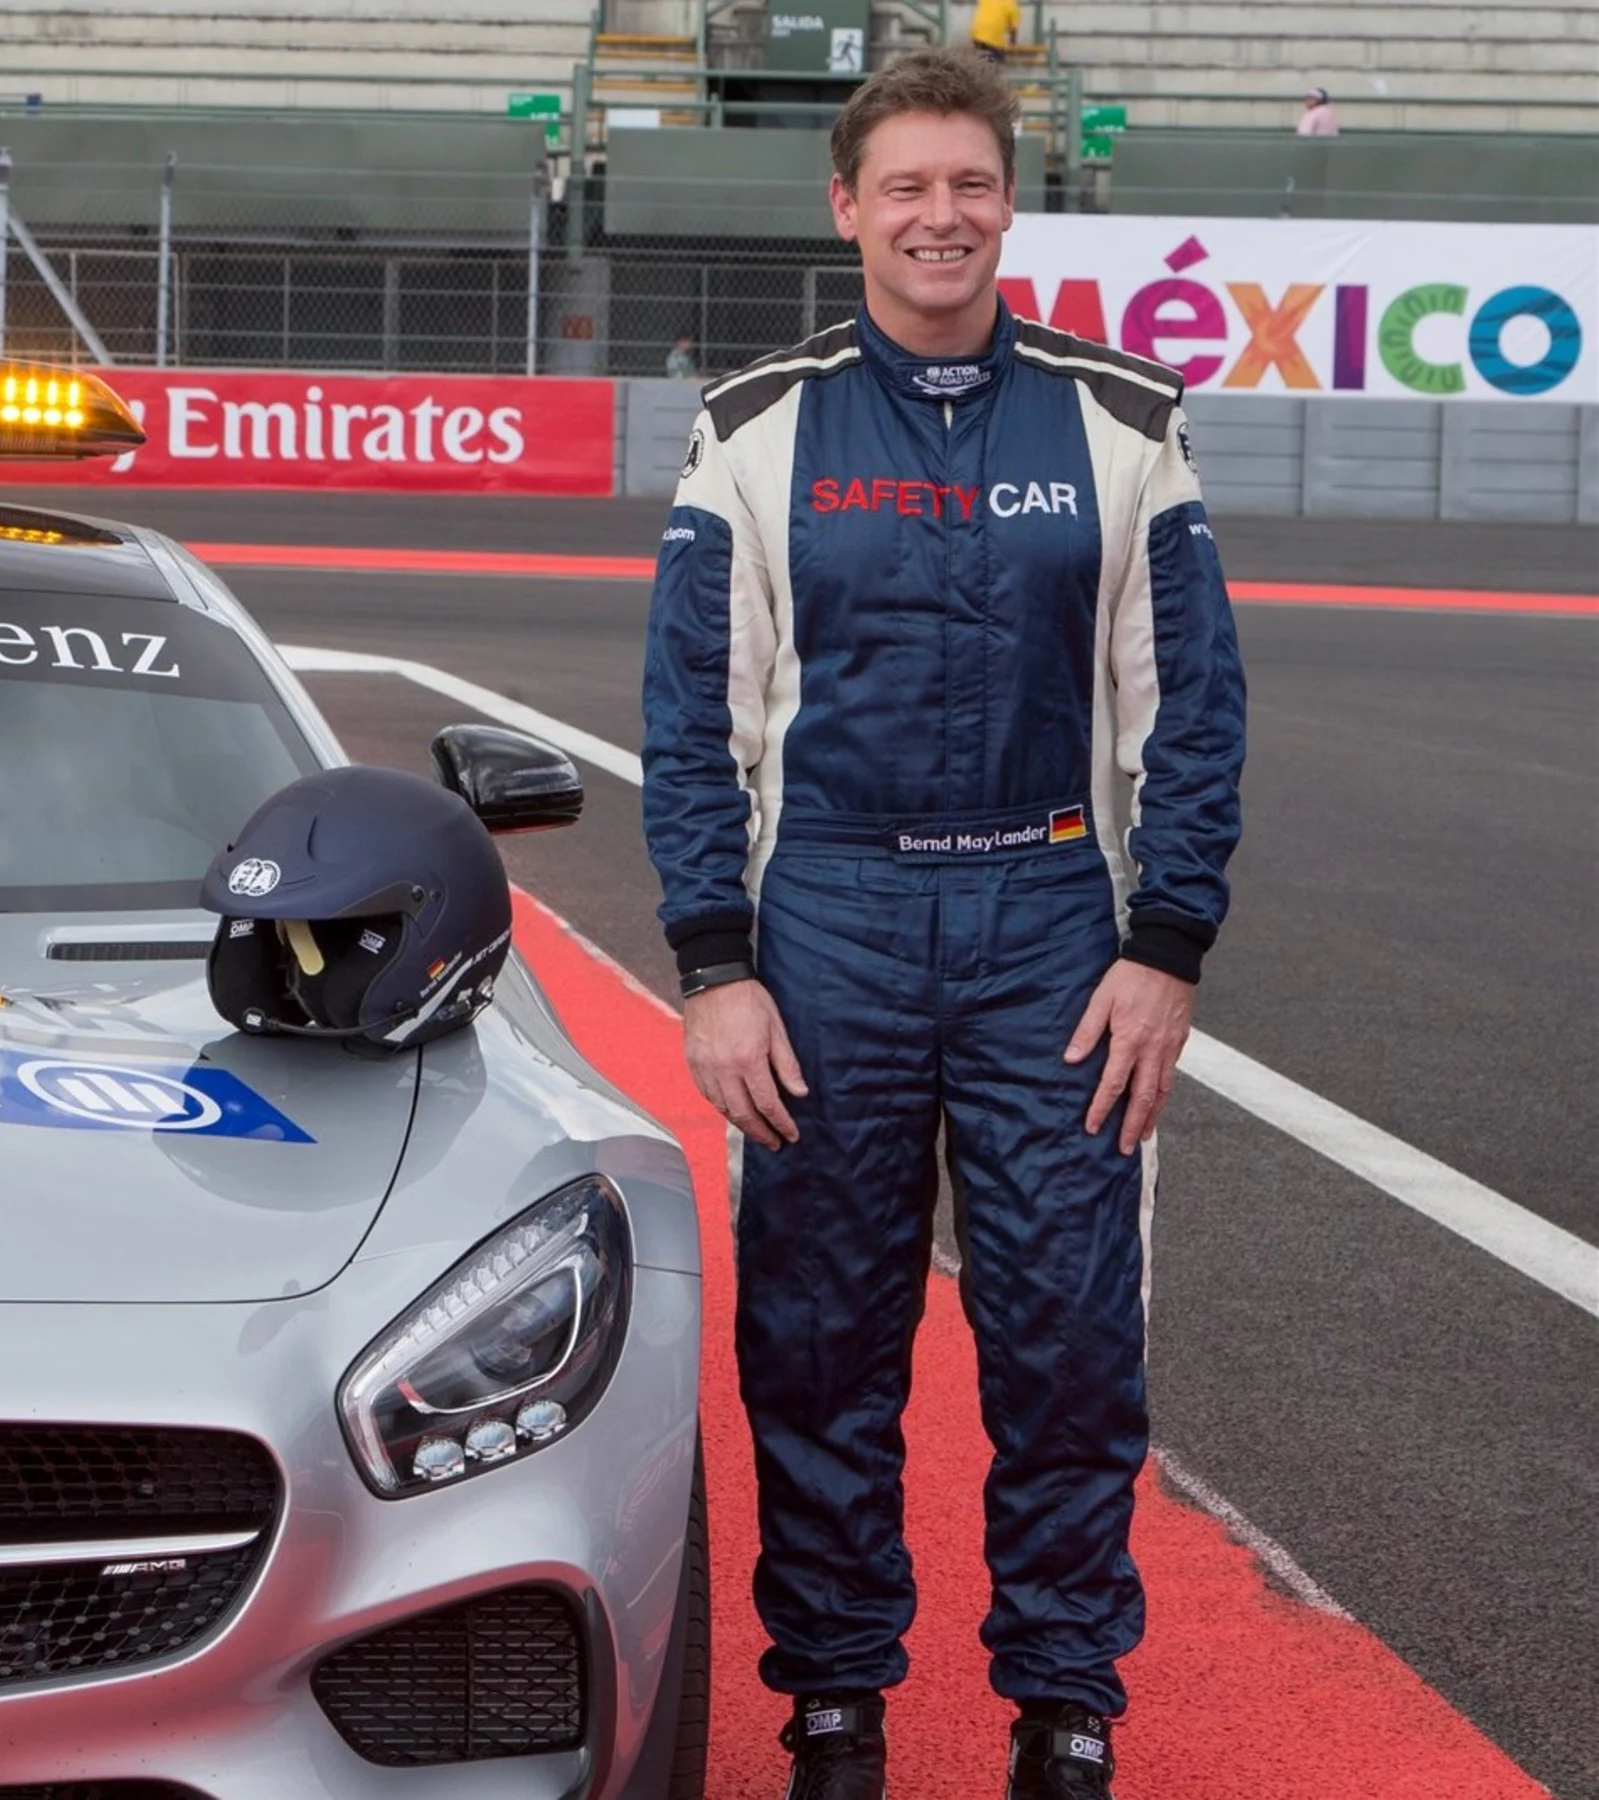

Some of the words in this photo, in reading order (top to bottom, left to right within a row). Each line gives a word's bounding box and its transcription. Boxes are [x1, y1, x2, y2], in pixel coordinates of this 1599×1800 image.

[167, 386, 524, 464] Emirates
[811, 477, 980, 520] SAFETY
[989, 481, 1078, 518] CAR
[899, 835, 951, 851] Bernd
[231, 863, 279, 892] FIA
[230, 921, 255, 935] OMP
[360, 933, 384, 949] OMP
[807, 1712, 841, 1730] OMP
[1070, 1738, 1104, 1758] OMP
